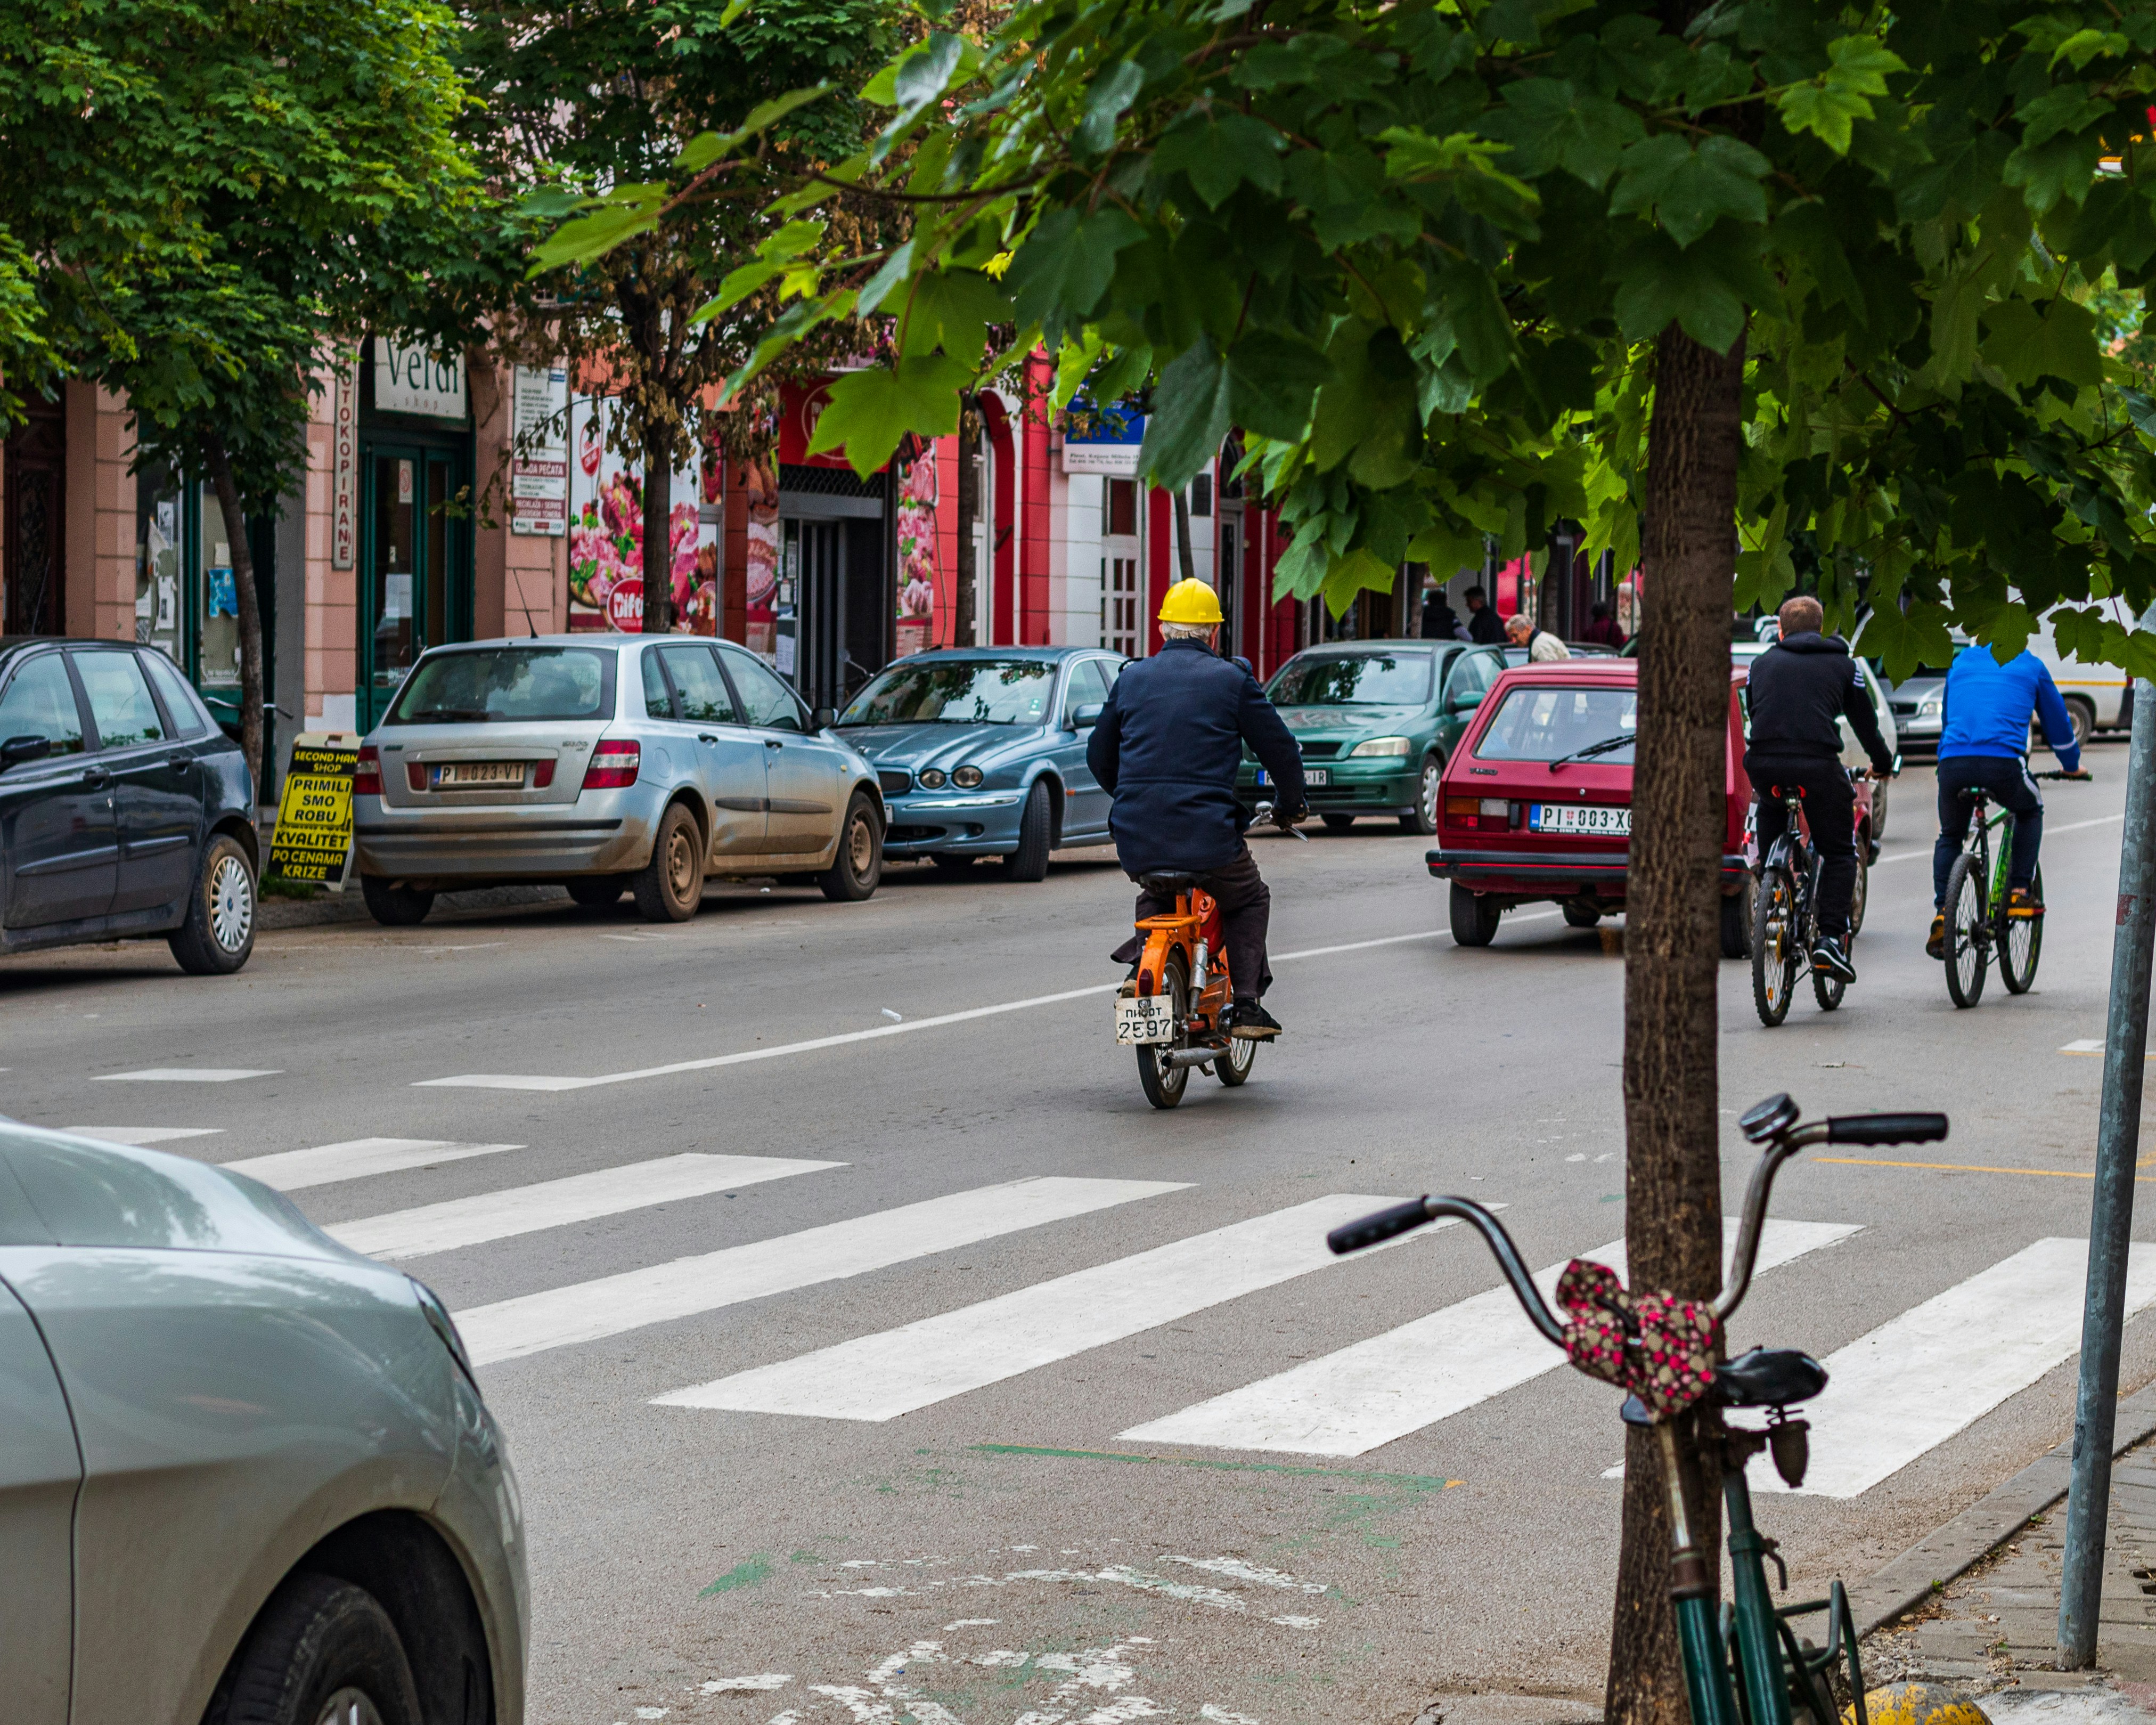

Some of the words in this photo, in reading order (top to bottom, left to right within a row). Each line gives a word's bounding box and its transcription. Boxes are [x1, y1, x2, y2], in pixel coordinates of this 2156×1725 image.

[294, 751, 334, 762] SECOND
[335, 753, 358, 763] HAN
[313, 763, 342, 772] SHOP
[293, 779, 349, 793] PRIMILI
[302, 795, 335, 807] SMO
[295, 809, 337, 822] ROBU
[1544, 808, 1562, 825] PI
[272, 849, 289, 862] PO
[291, 850, 344, 866] CENAMA
[282, 864, 328, 880] KRIZE
[1118, 1019, 1171, 1039] 2597
